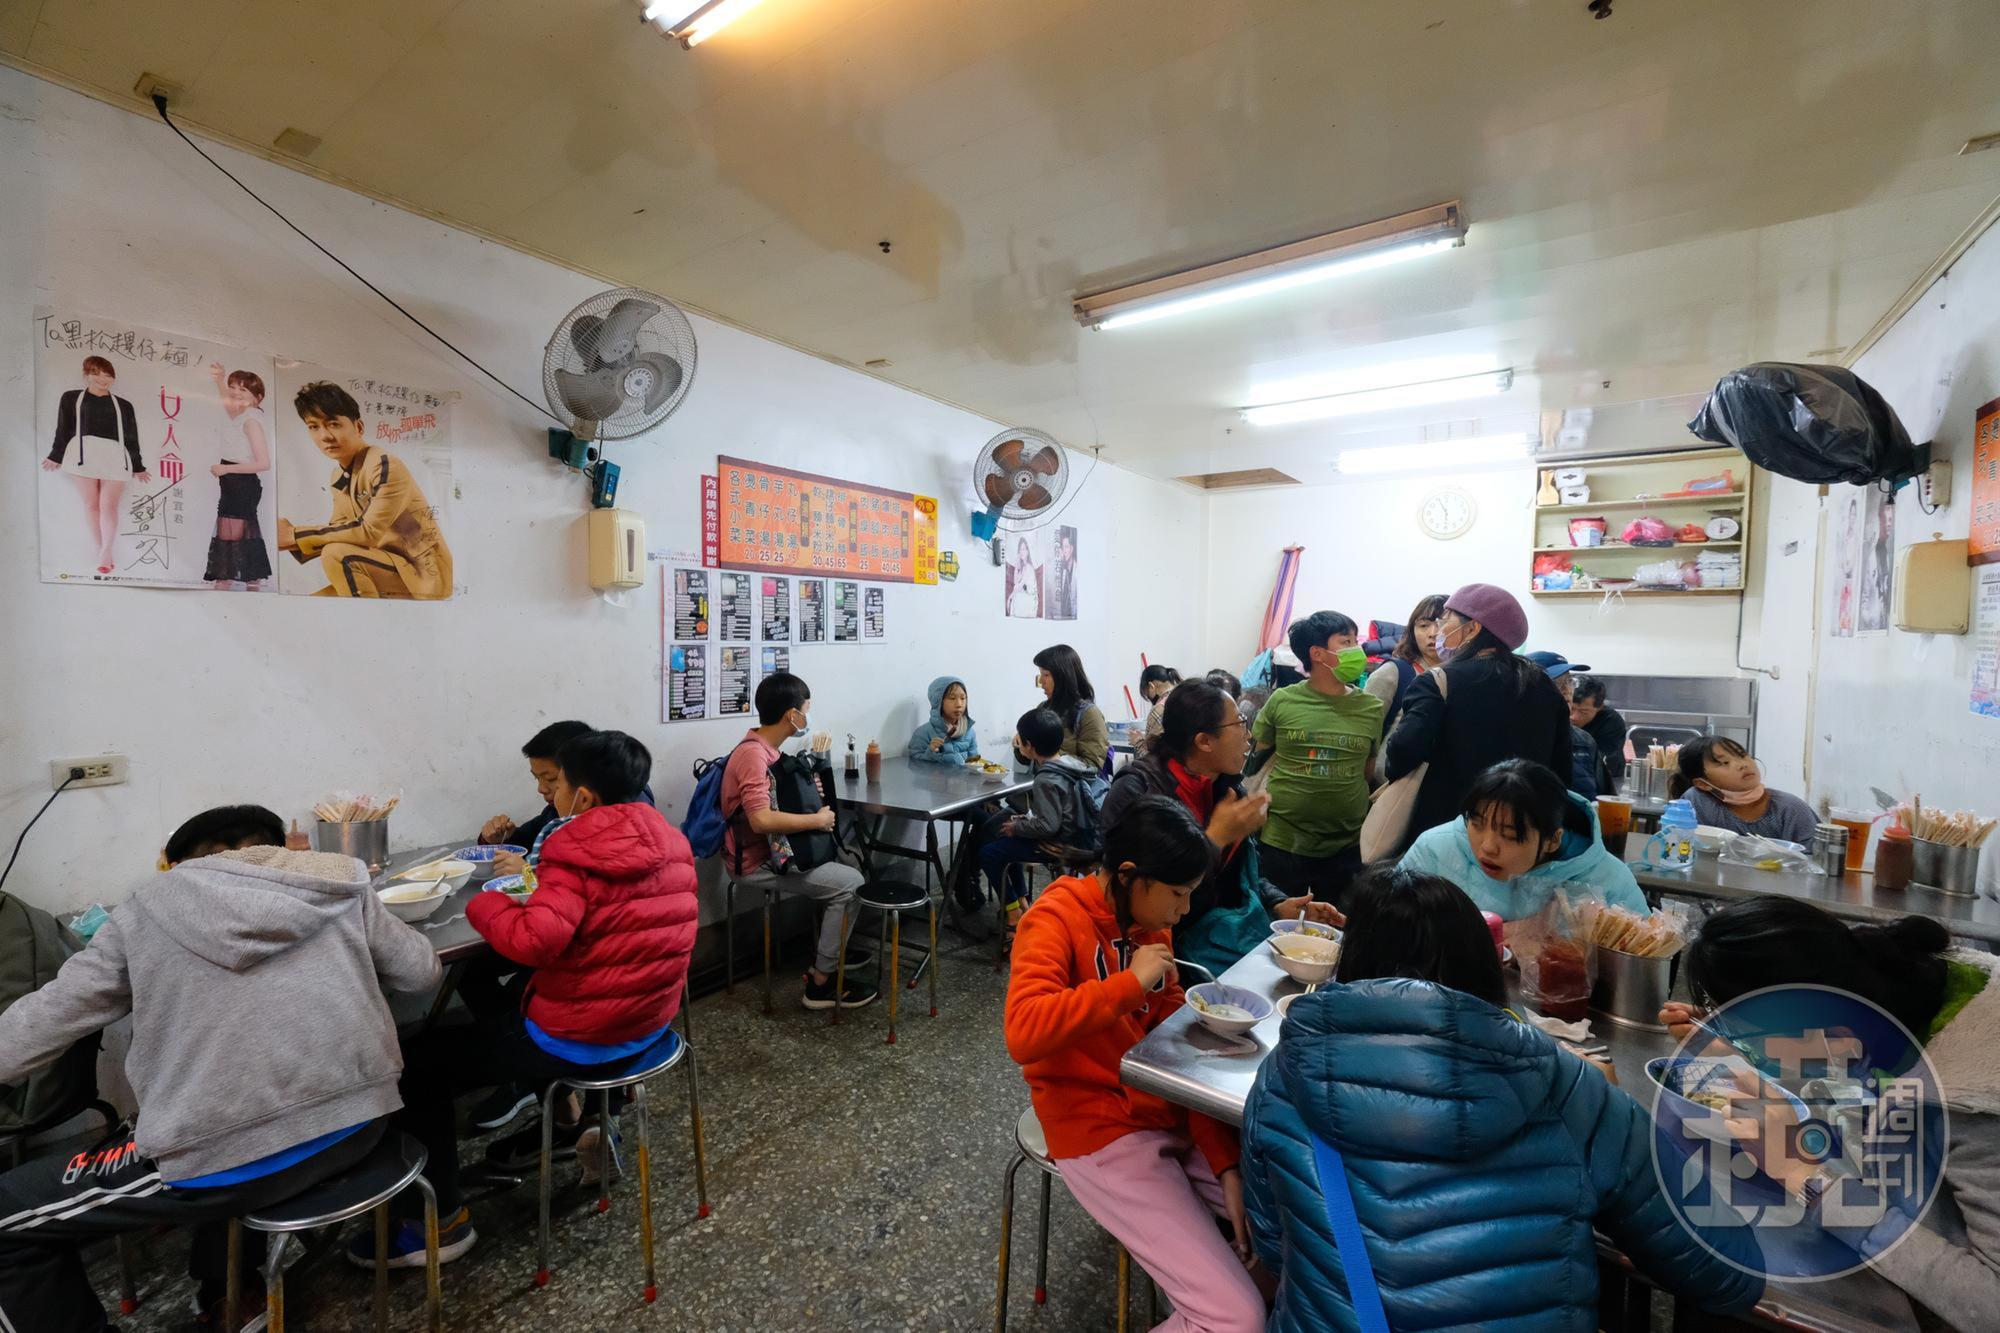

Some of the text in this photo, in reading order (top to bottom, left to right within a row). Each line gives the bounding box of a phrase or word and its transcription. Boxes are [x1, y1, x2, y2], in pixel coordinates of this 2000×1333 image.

[158, 385, 184, 485] 女人命
[729, 469, 742, 544] 各式小菜
[759, 551, 770, 562] 25
[774, 552, 784, 563] 25
[813, 555, 823, 566] 30
[825, 557, 835, 568] 45
[837, 558, 847, 569] 65
[859, 561, 869, 571] 25
